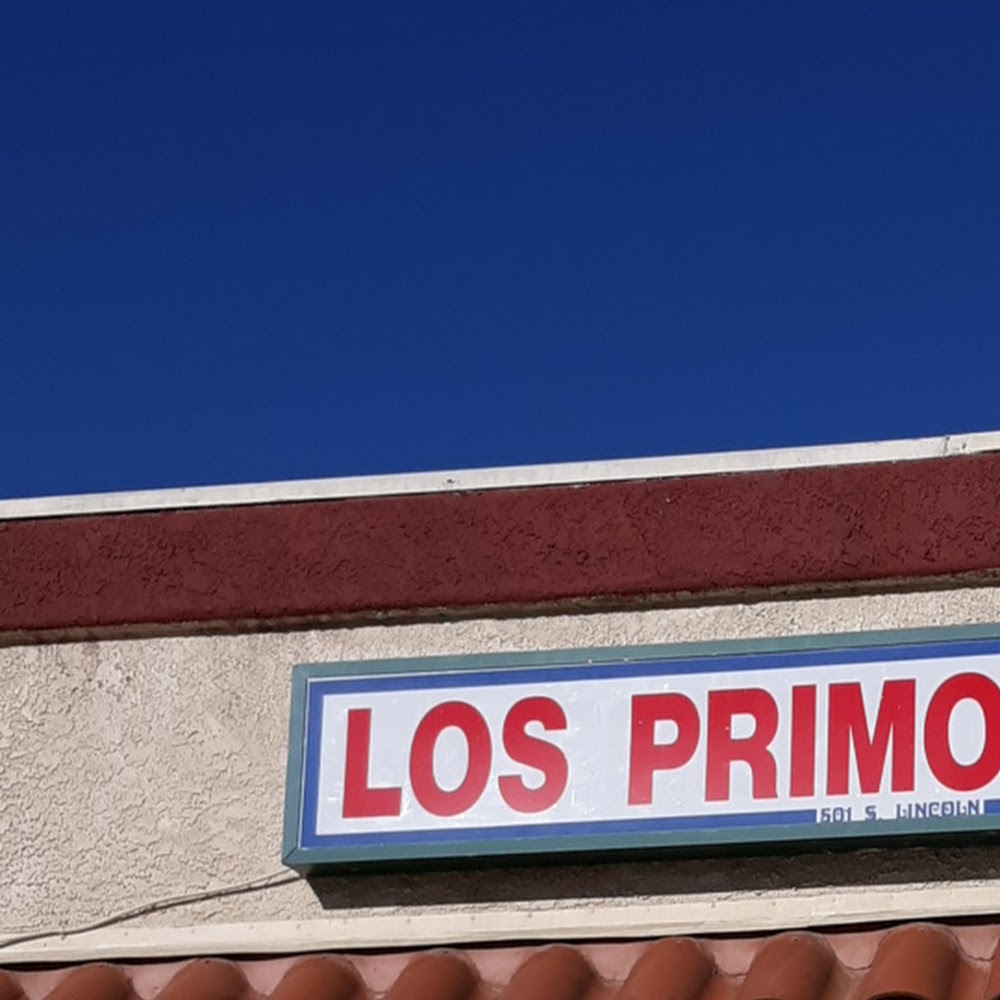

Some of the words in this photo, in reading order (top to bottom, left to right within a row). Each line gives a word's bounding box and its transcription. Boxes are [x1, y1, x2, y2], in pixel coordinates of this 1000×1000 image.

[342, 695, 569, 819] LOS
[820, 806, 852, 823] 501
[896, 799, 980, 820] LINCOLN
